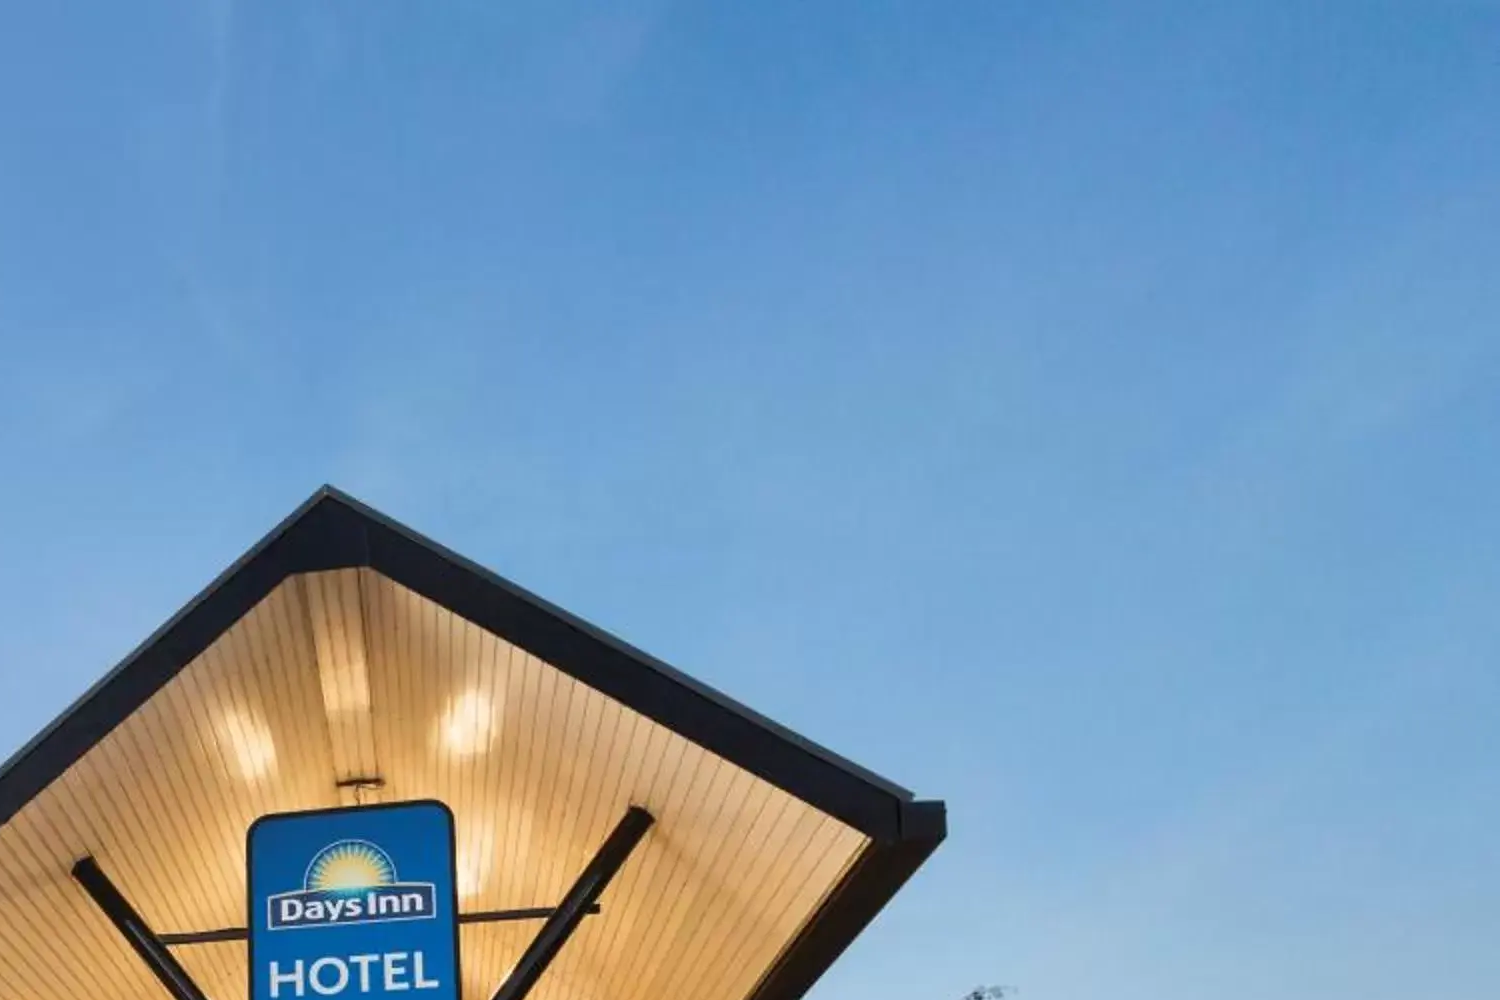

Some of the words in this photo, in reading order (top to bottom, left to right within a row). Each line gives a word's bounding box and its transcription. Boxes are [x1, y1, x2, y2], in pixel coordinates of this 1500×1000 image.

[280, 898, 362, 922] Days
[367, 891, 424, 915] Inn
[269, 950, 439, 998] HOTEL
